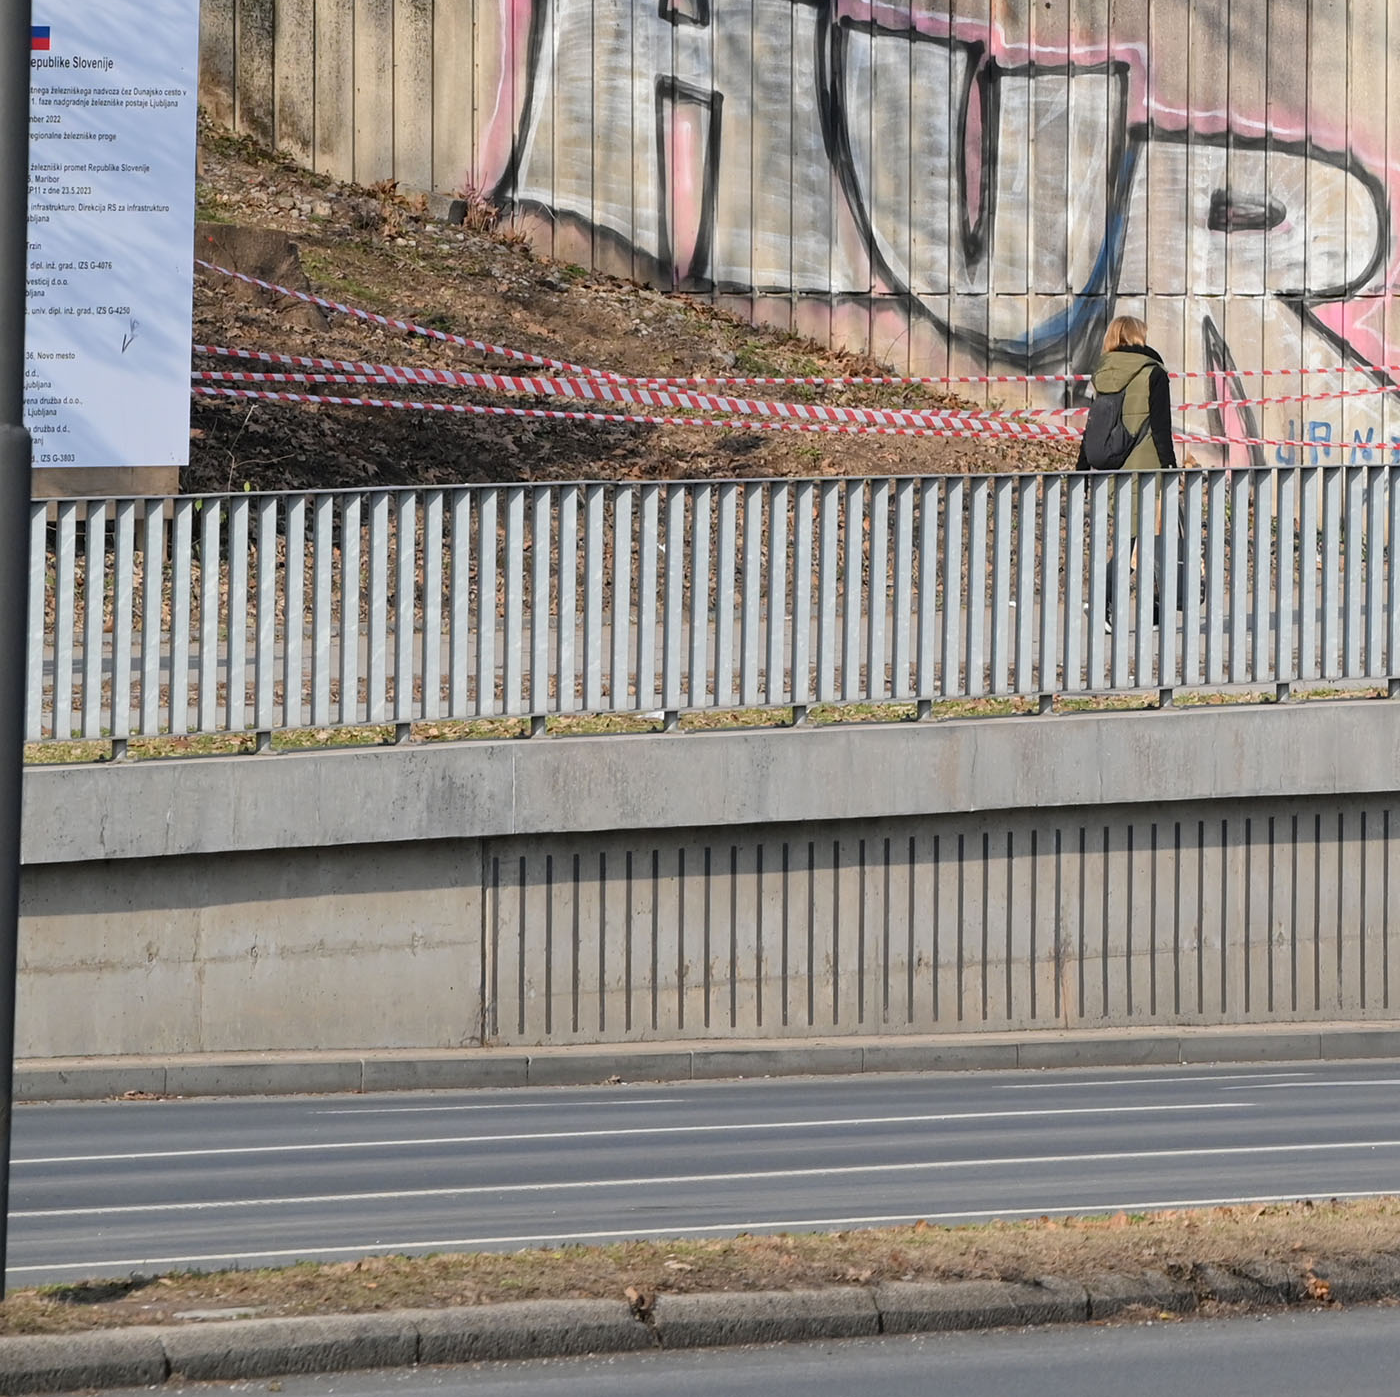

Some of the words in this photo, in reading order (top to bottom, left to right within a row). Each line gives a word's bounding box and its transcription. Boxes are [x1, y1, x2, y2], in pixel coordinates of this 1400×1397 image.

[30, 56, 70, 71] epublike
[72, 56, 114, 72] Slovenije
[93, 87, 119, 96] nadvoza
[133, 87, 163, 98] Dunajsko
[164, 88, 181, 96] cesto
[38, 97, 51, 106] faze
[53, 97, 89, 108] nadgradnje
[125, 99, 148, 109] postaje
[149, 98, 178, 109] Ljubljana
[45, 115, 61, 123] 2022
[98, 134, 117, 142] proge
[63, 164, 87, 173] promet
[88, 163, 119, 173] Republike
[121, 163, 150, 173] Slovenije
[34, 175, 59, 183] Maribor
[48, 186, 60, 195] dne
[61, 187, 92, 195] 23.5.2023
[78, 203, 106, 213] Direkcija
[107, 203, 117, 212] RS
[126, 203, 170, 212] infrastrukturo
[30, 261, 43, 270] dipl.
[78, 261, 89, 270] IZS
[90, 261, 112, 270] G-4076
[48, 306, 63, 316] dipl.
[96, 306, 107, 315] IZS
[108, 306, 130, 315] G-4250
[37, 351, 54, 360] Novo
[55, 352, 76, 360] mesto
[24, 381, 51, 390] jubljana
[39, 397, 62, 405] družba
[27, 408, 57, 418] Ljubljana
[33, 425, 55, 433] družba
[40, 454, 51, 463] IZS
